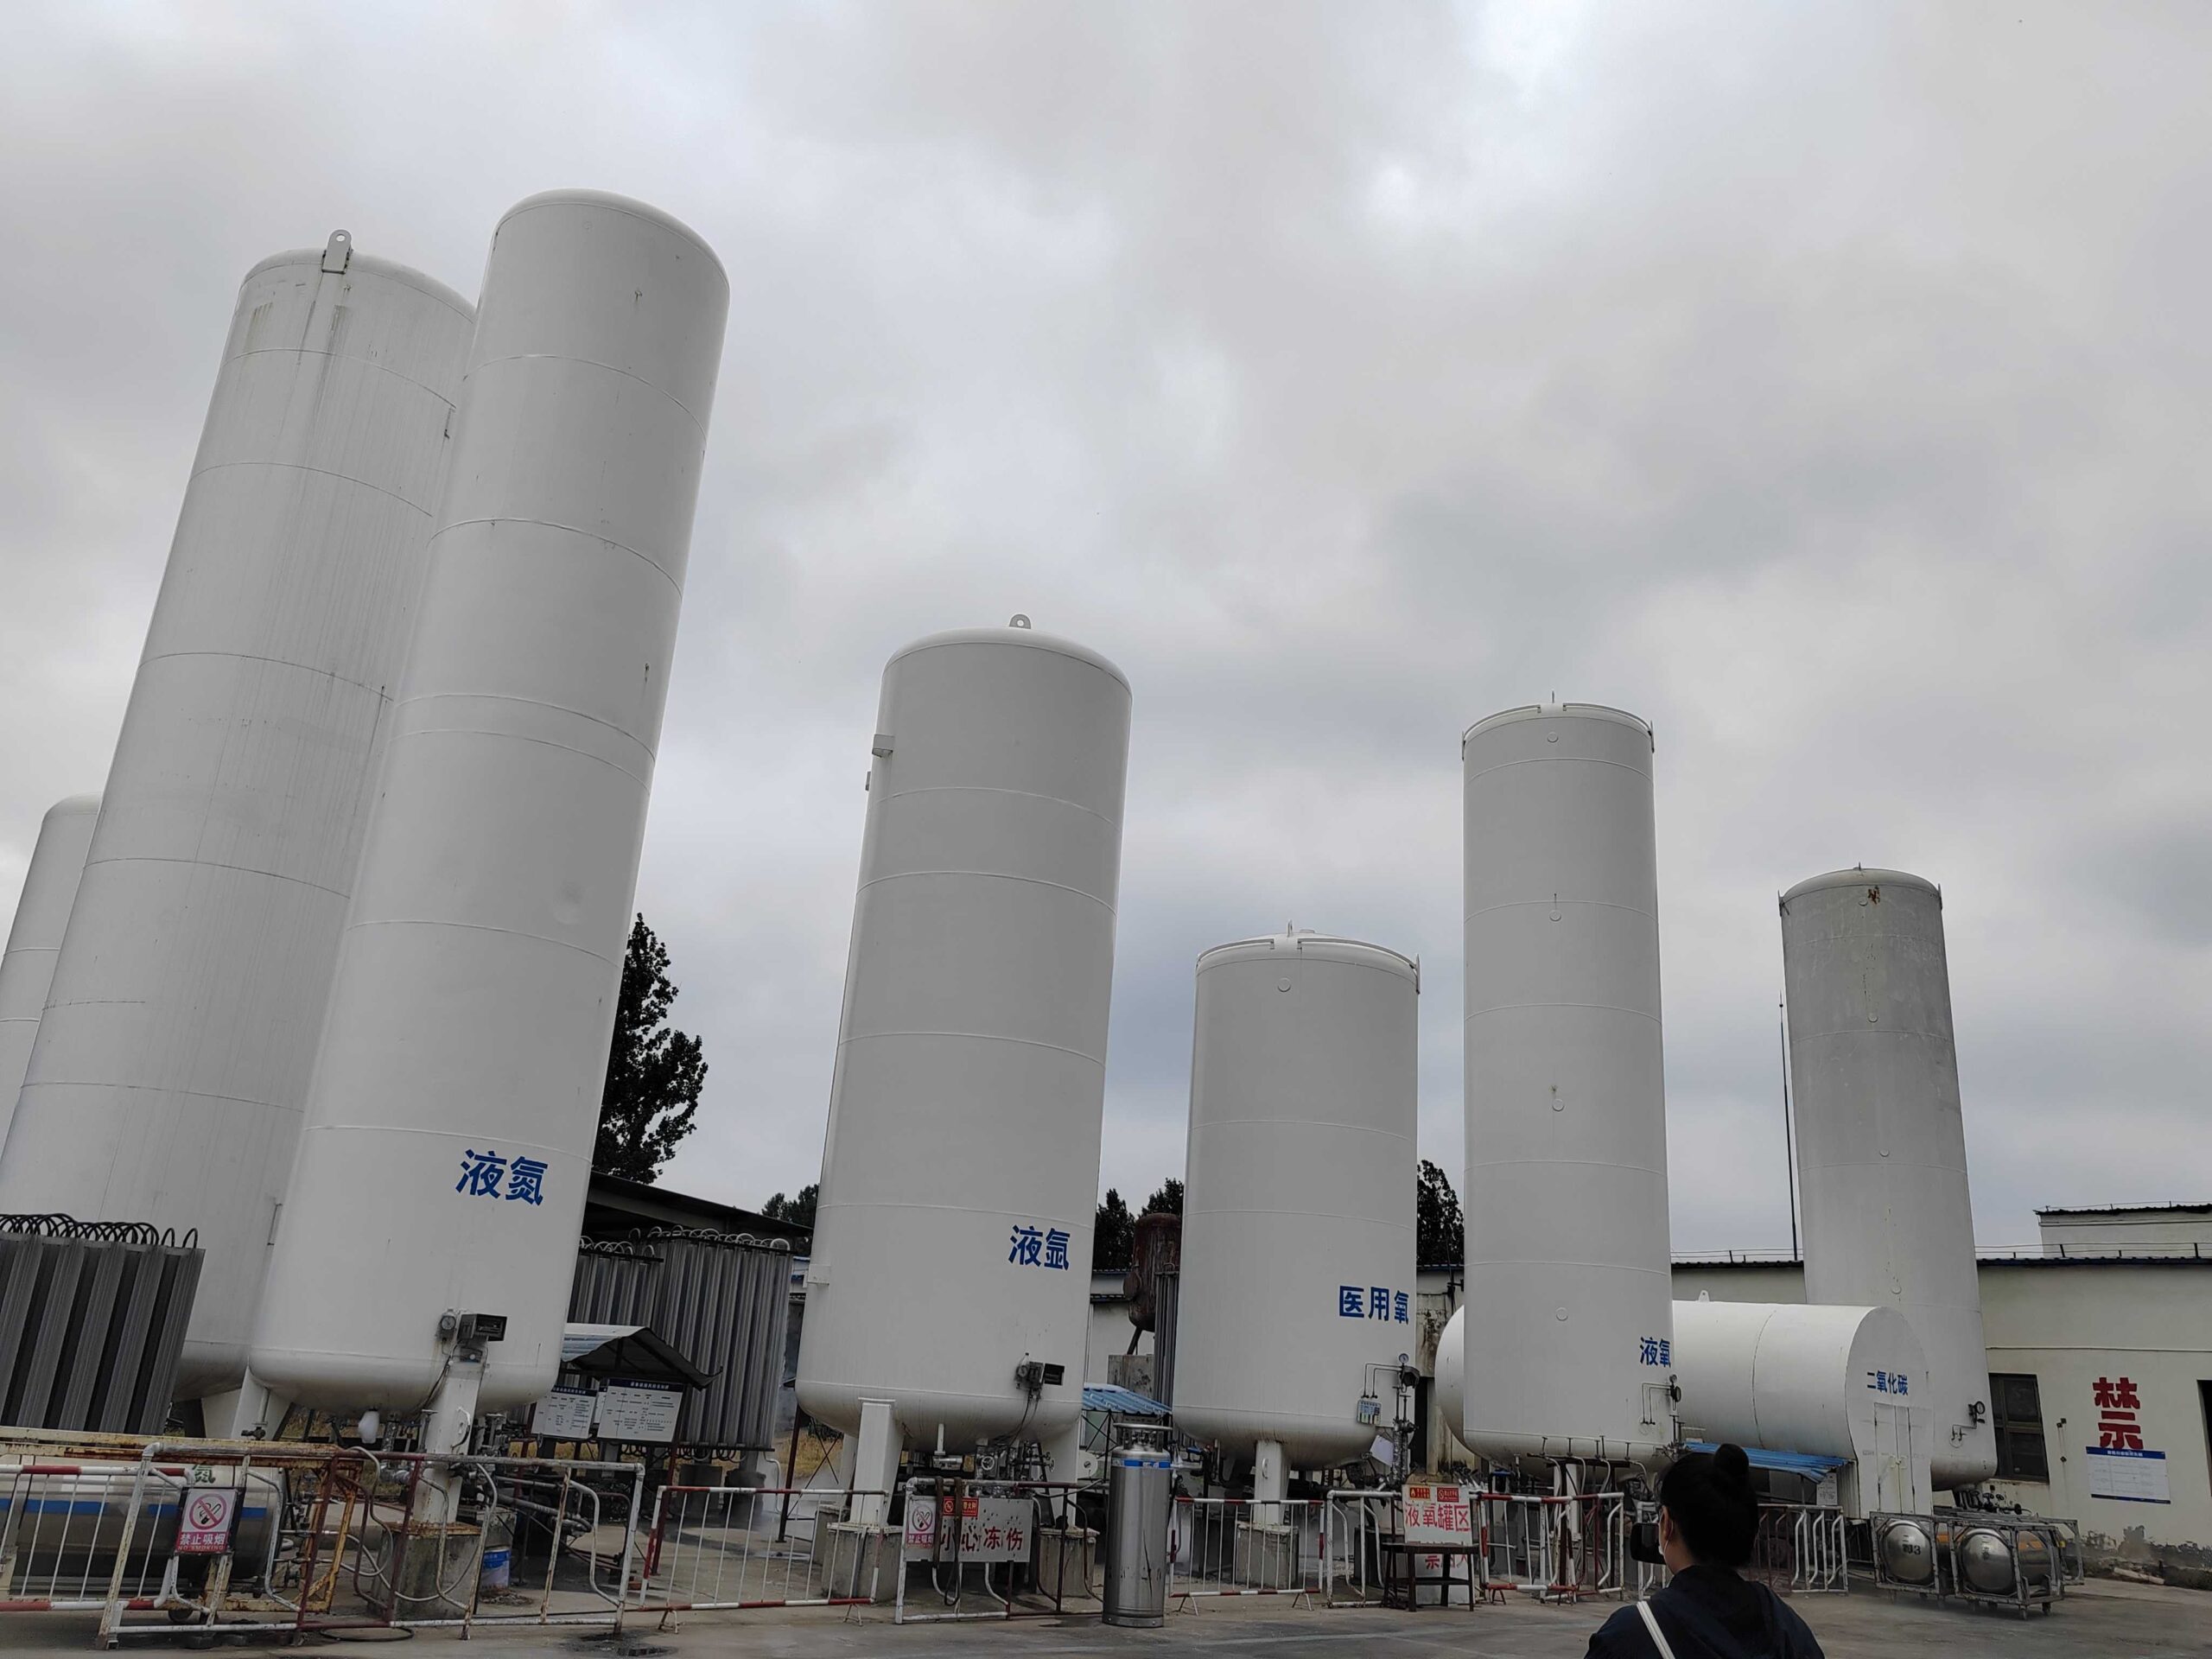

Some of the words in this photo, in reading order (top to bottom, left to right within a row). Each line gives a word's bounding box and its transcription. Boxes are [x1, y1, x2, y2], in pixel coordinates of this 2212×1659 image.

[455, 1148, 548, 1206] 液氮
[1008, 1224, 1071, 1271] 液氩
[1339, 1285, 1409, 1325] 医用氧
[1640, 1337, 1671, 1368] 液氧
[1867, 1370, 1909, 1396] 二氧化碳
[2092, 1377, 2144, 1449] 禁
[1405, 1503, 1471, 1532] 液氧罐区
[180, 1534, 226, 1545] 禁止吸烟
[940, 1526, 1024, 1552] 小心冻伤
